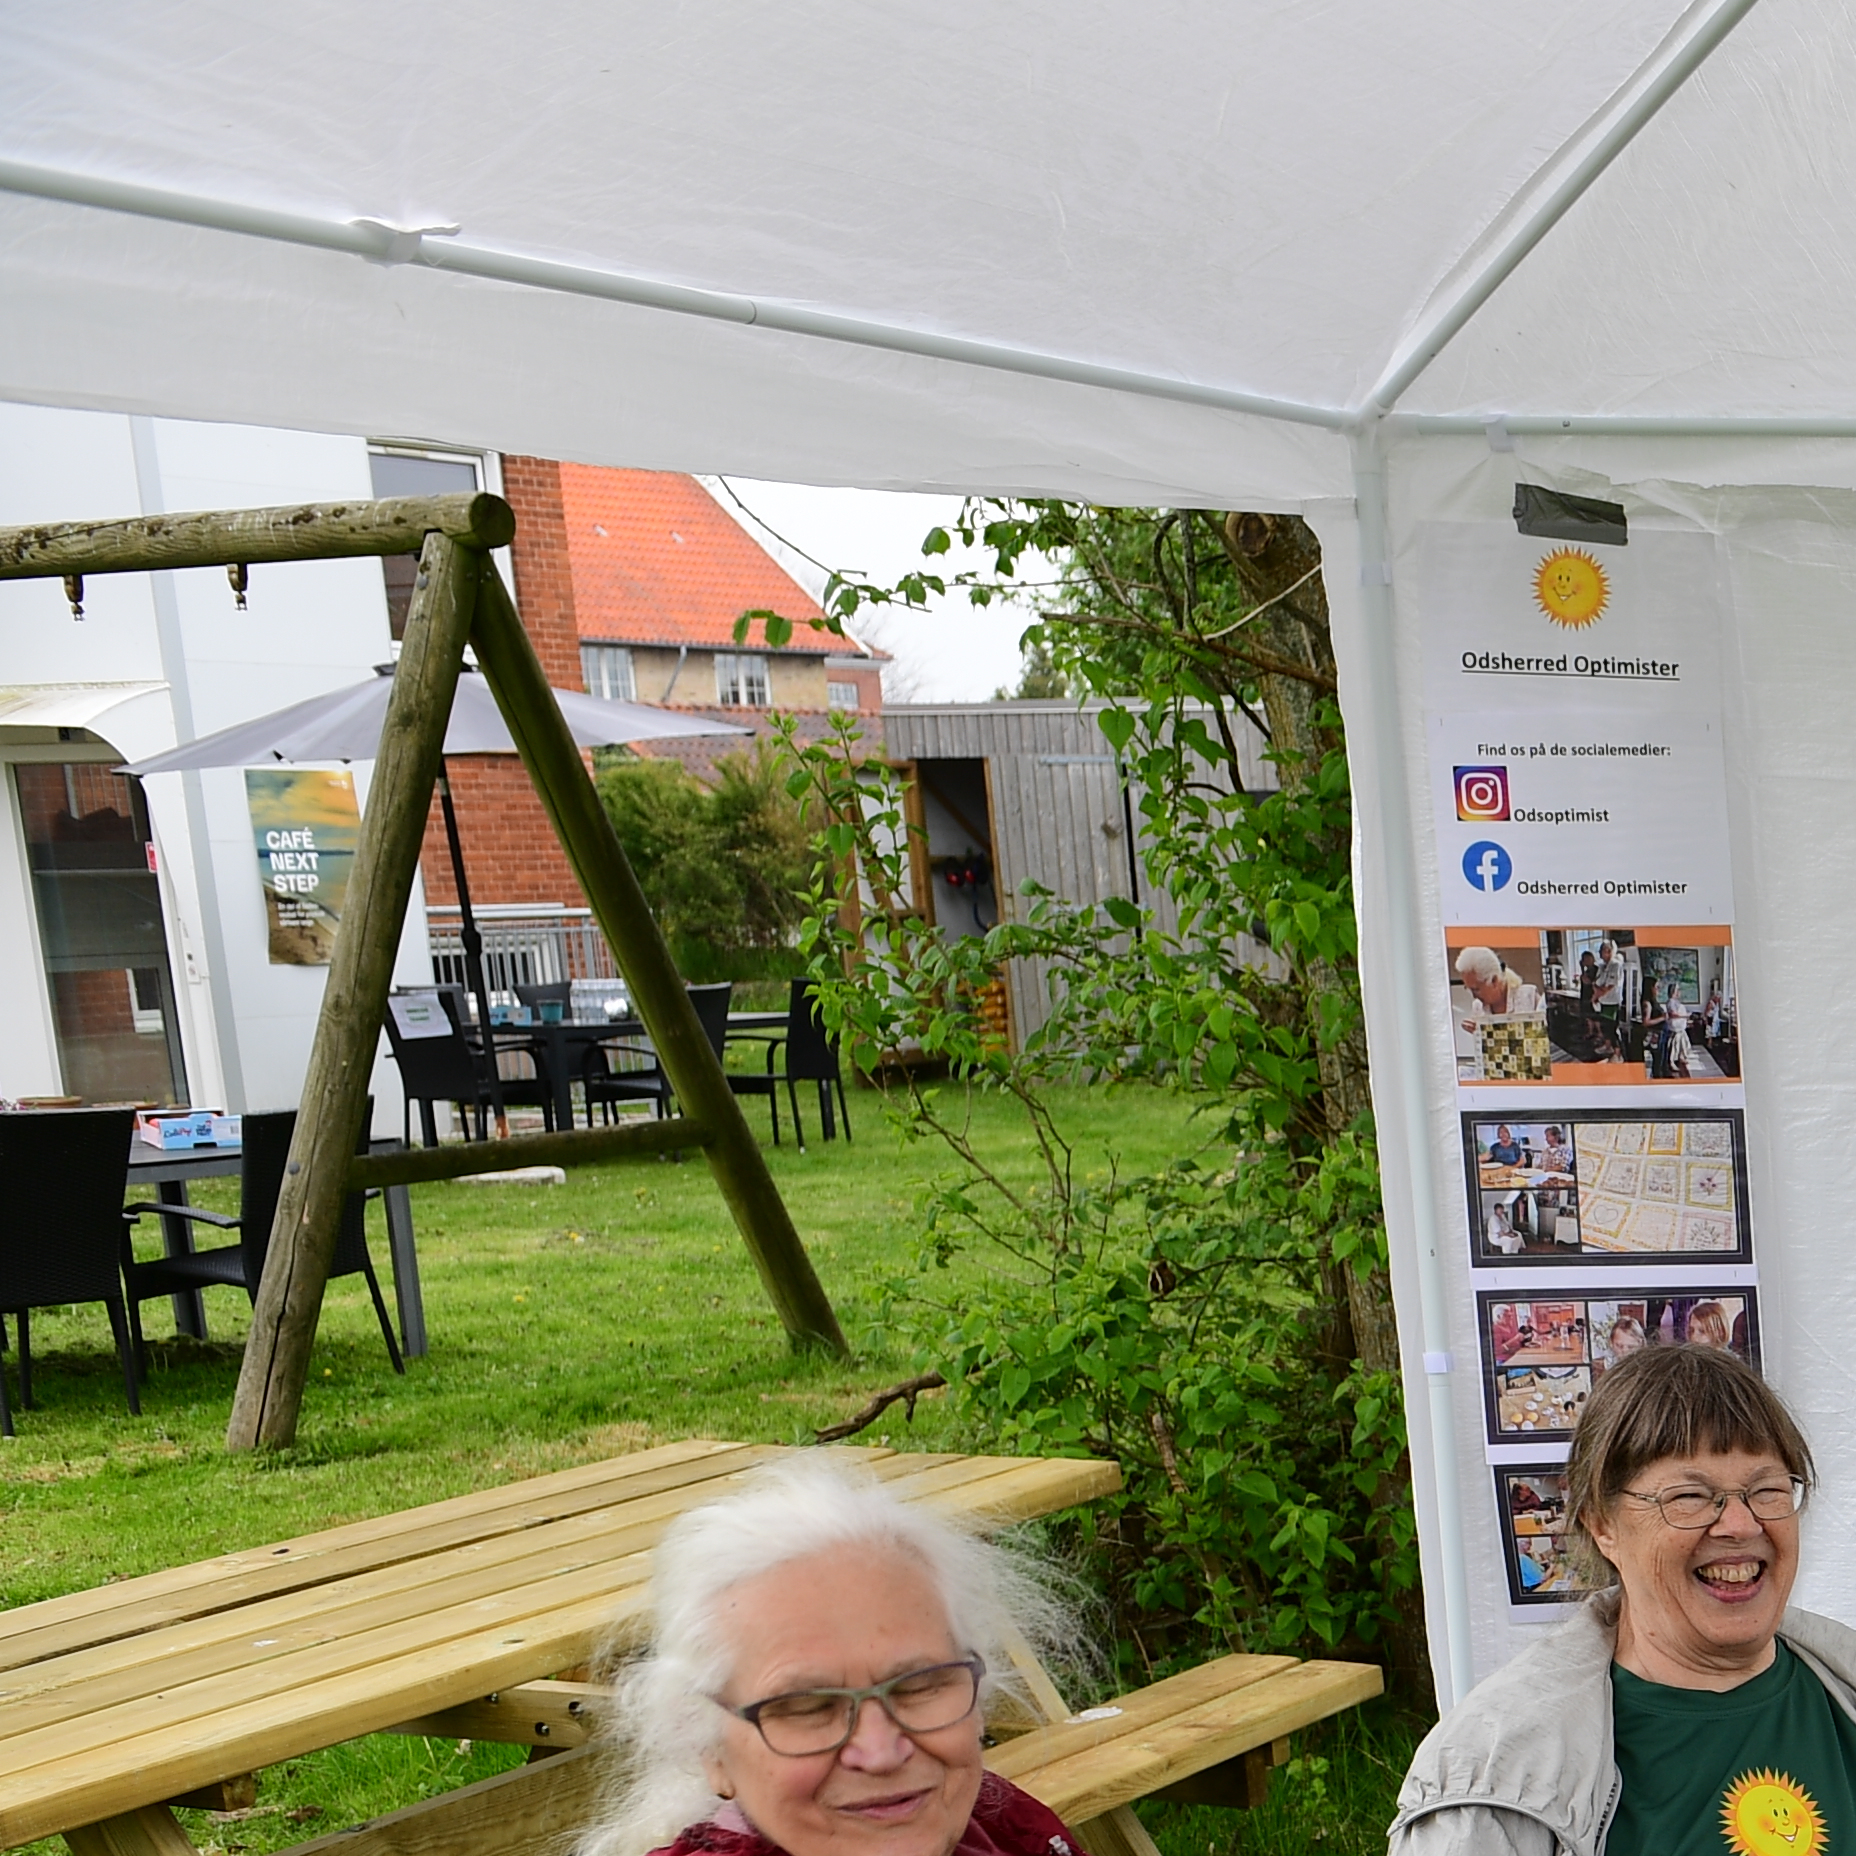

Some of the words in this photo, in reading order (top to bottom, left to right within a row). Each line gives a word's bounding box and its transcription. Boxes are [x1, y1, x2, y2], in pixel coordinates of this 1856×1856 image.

[1461, 652, 1568, 672] Odsherred
[1574, 655, 1680, 678] Optimister
[1477, 744, 1507, 757] Find
[1510, 746, 1526, 757] os
[1529, 743, 1547, 758] på
[1550, 743, 1567, 756] de
[1571, 743, 1672, 757] socialemedier:
[1513, 808, 1610, 825] Odsoptimist
[266, 826, 316, 850] CAFÉ
[269, 852, 319, 871] NEXT
[273, 874, 319, 893] STEP
[1517, 880, 1600, 895] Odsherred
[1603, 880, 1688, 898] Optimister
